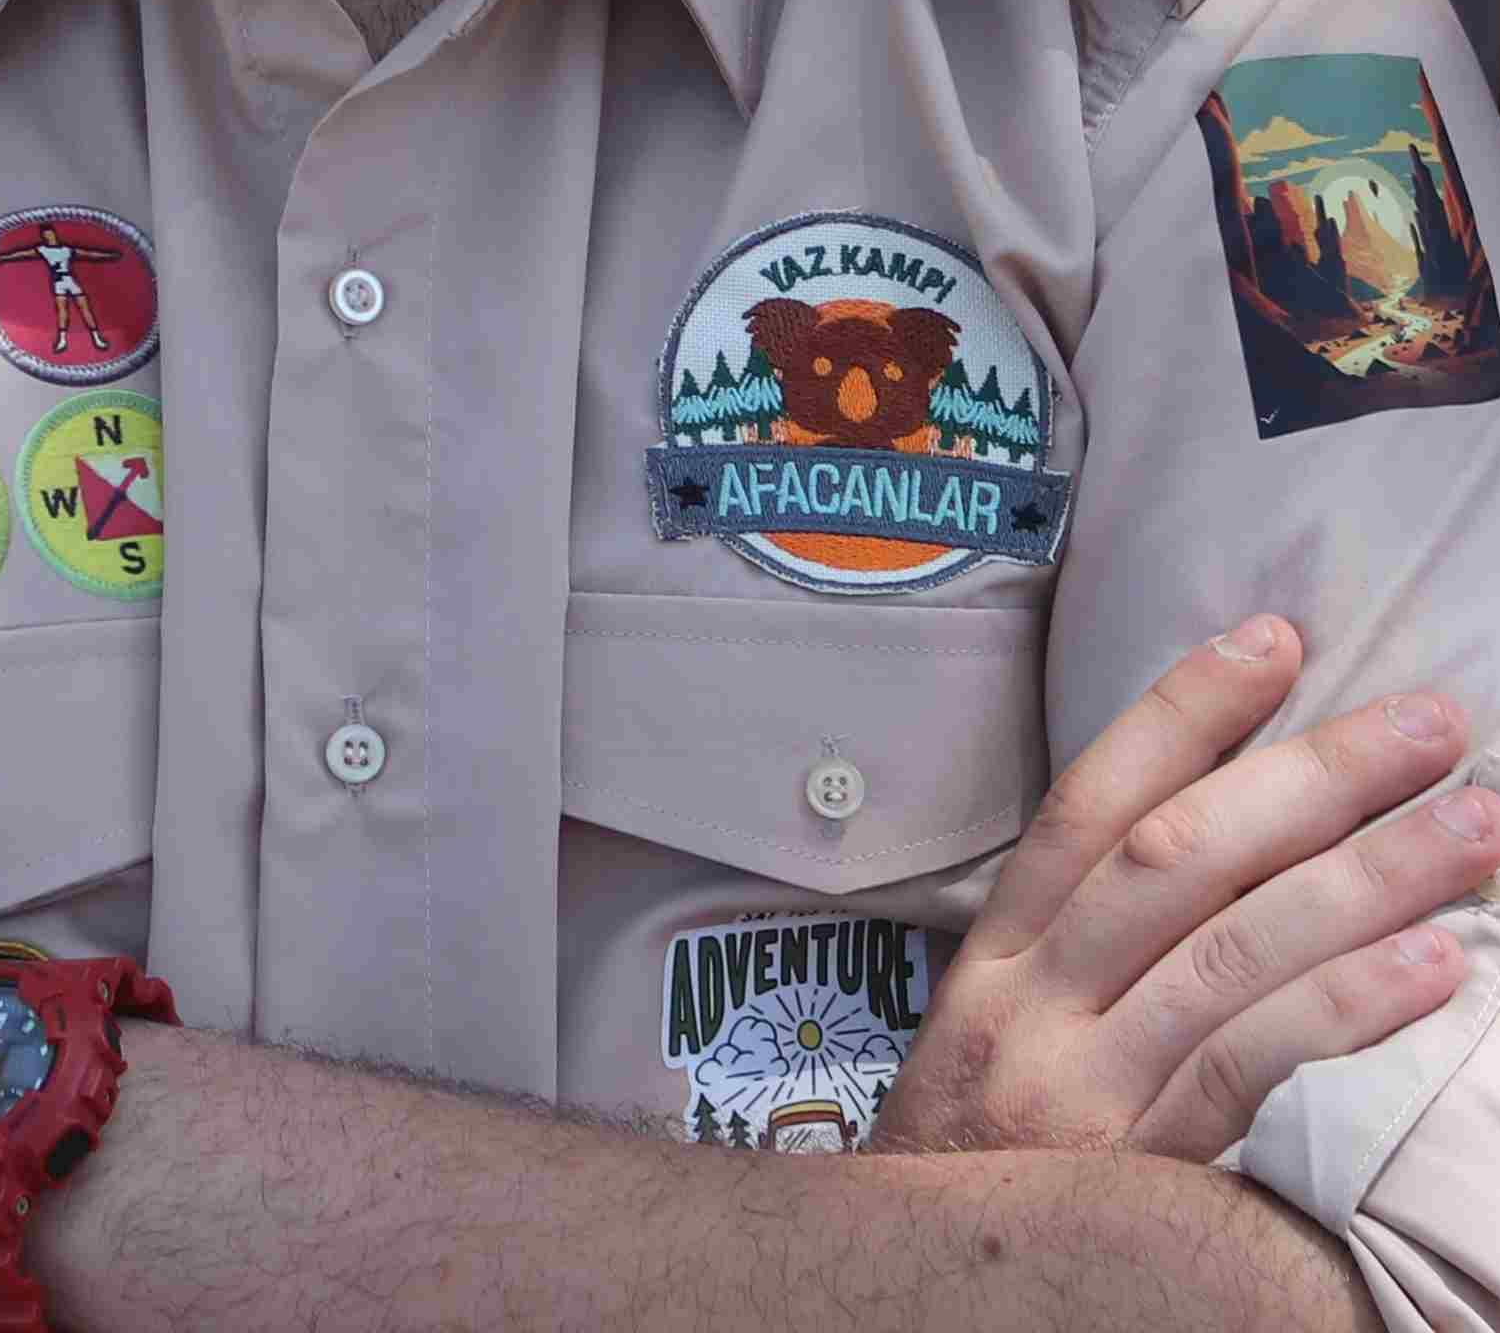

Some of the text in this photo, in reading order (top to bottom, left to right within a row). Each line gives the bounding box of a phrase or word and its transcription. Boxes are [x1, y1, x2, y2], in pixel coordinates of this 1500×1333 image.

[760, 246, 832, 292] YAZ
[94, 414, 123, 446] N
[40, 487, 78, 519] W
[718, 461, 1002, 535] AFACANLAR
[119, 541, 146, 575] S
[669, 918, 922, 1057] ADVENTURE
